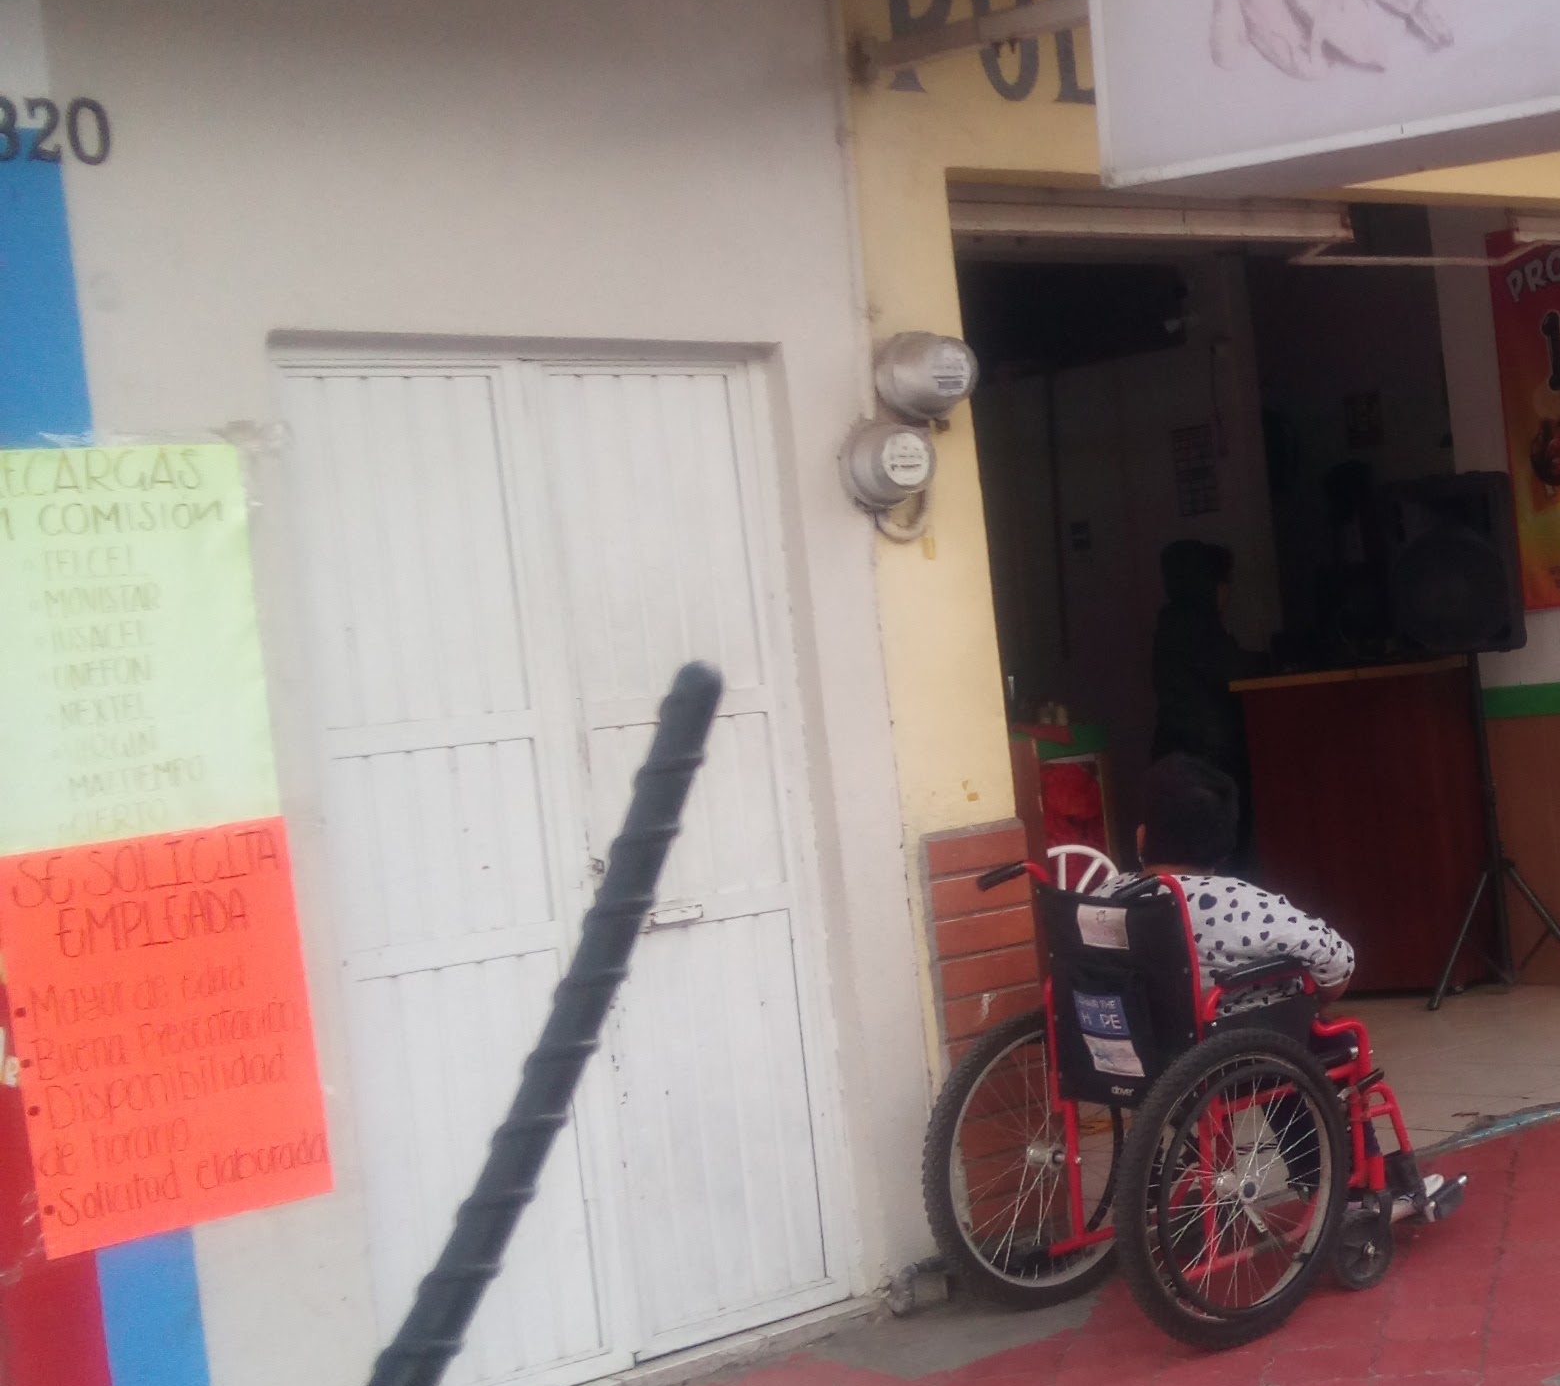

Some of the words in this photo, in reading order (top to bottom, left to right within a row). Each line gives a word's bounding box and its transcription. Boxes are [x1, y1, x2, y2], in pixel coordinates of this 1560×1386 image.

[0, 448, 204, 499] ECARGAS
[11, 855, 76, 909] SE
[84, 827, 282, 896] SOLICITA
[54, 887, 251, 958] EMPLEADA
